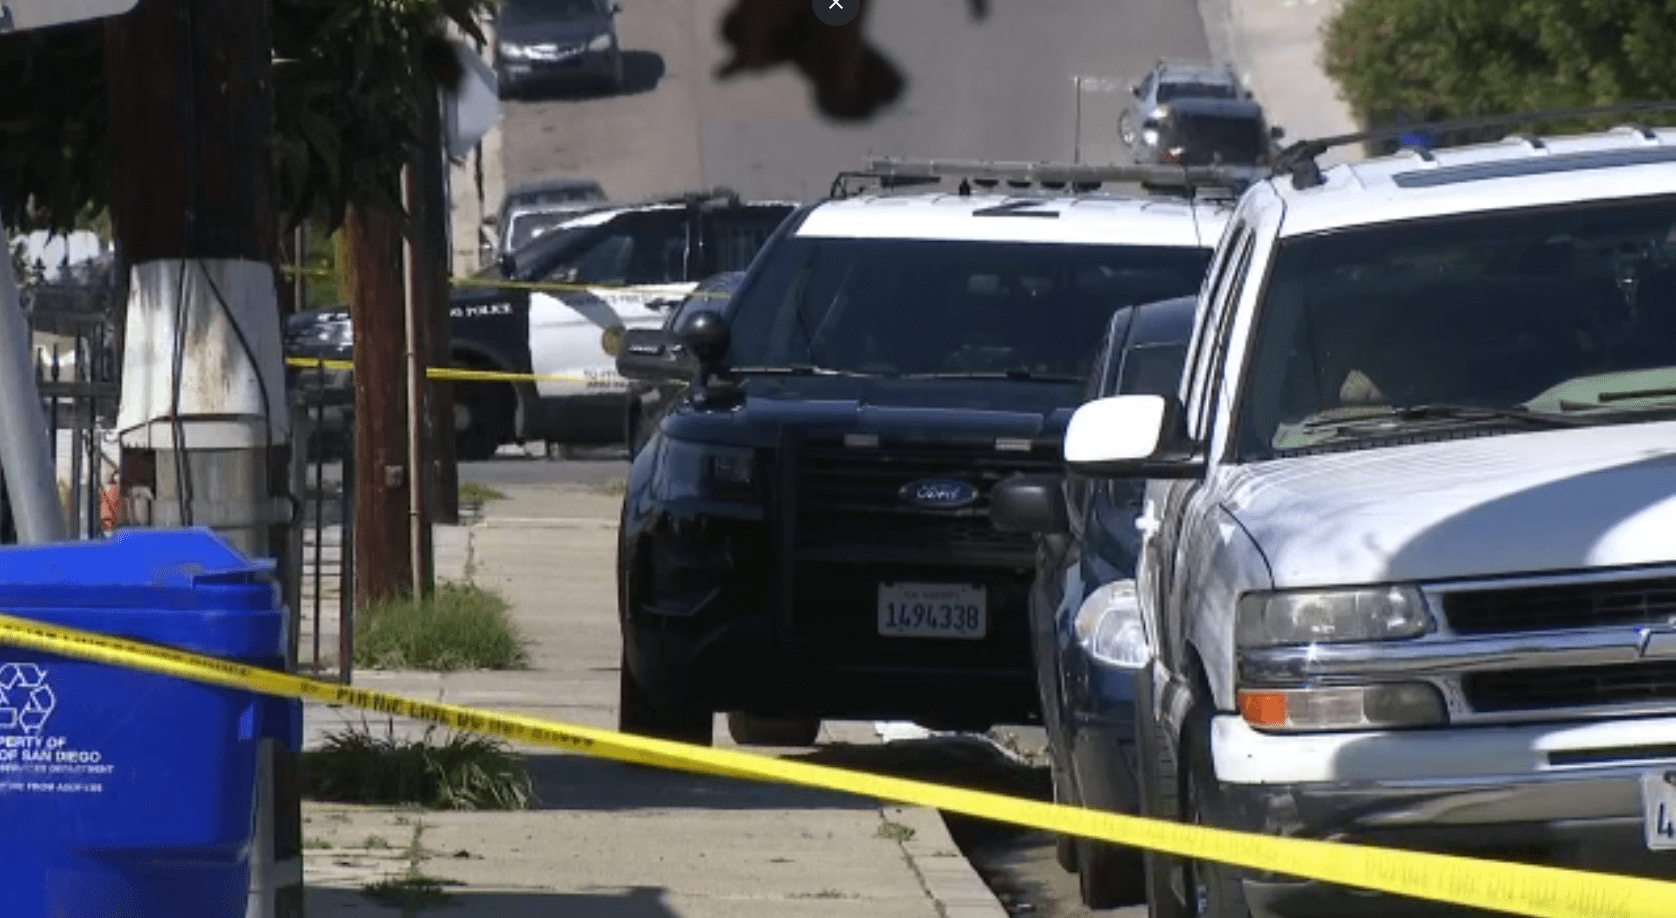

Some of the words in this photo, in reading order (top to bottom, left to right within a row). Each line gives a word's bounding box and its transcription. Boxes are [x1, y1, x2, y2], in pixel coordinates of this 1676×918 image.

[46, 736, 67, 749] OF
[22, 749, 52, 762] SAN
[56, 750, 102, 763] DIEGO
